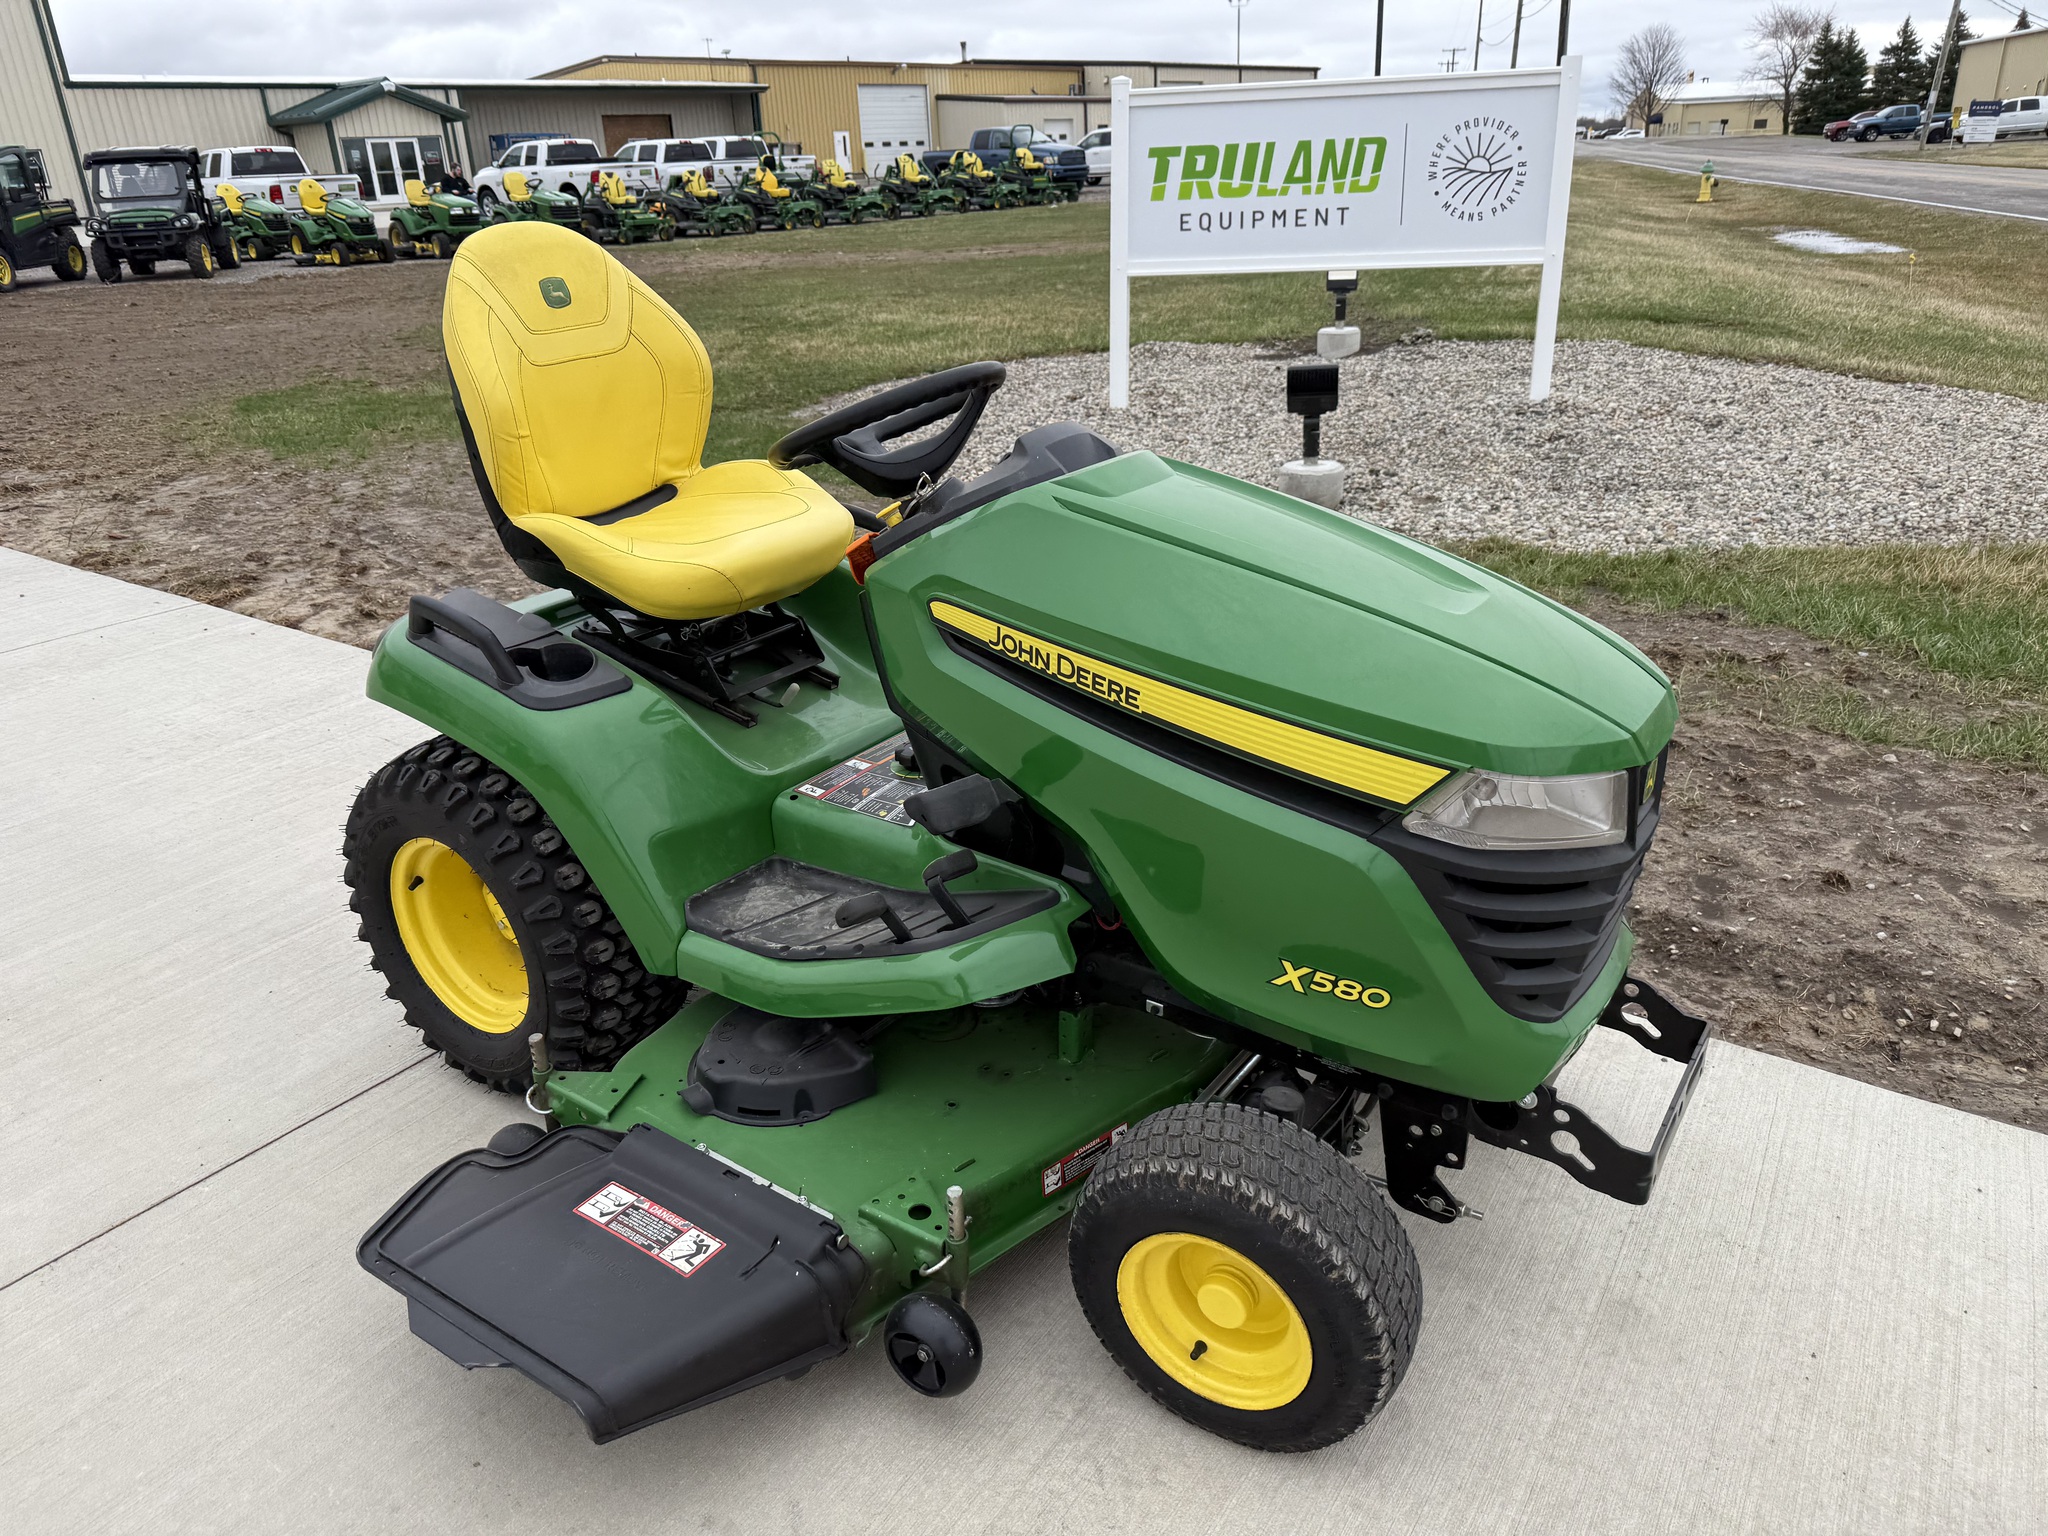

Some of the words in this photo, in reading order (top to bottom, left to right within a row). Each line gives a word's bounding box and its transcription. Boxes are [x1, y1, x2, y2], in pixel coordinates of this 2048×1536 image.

[1148, 136, 1387, 201] TRULAND
[1428, 134, 1451, 181] WHERE
[1455, 117, 1519, 141] PROVIDER
[1179, 206, 1350, 232] EQUIPMENT
[1441, 200, 1484, 222] MEANS
[1491, 160, 1527, 217] PARTNER
[988, 626, 1051, 672] JOHN
[1057, 653, 1142, 711] DEERE
[1268, 958, 1392, 1009] X580
[1078, 1137, 1100, 1155] DANGER
[650, 1205, 684, 1228] DANGER
